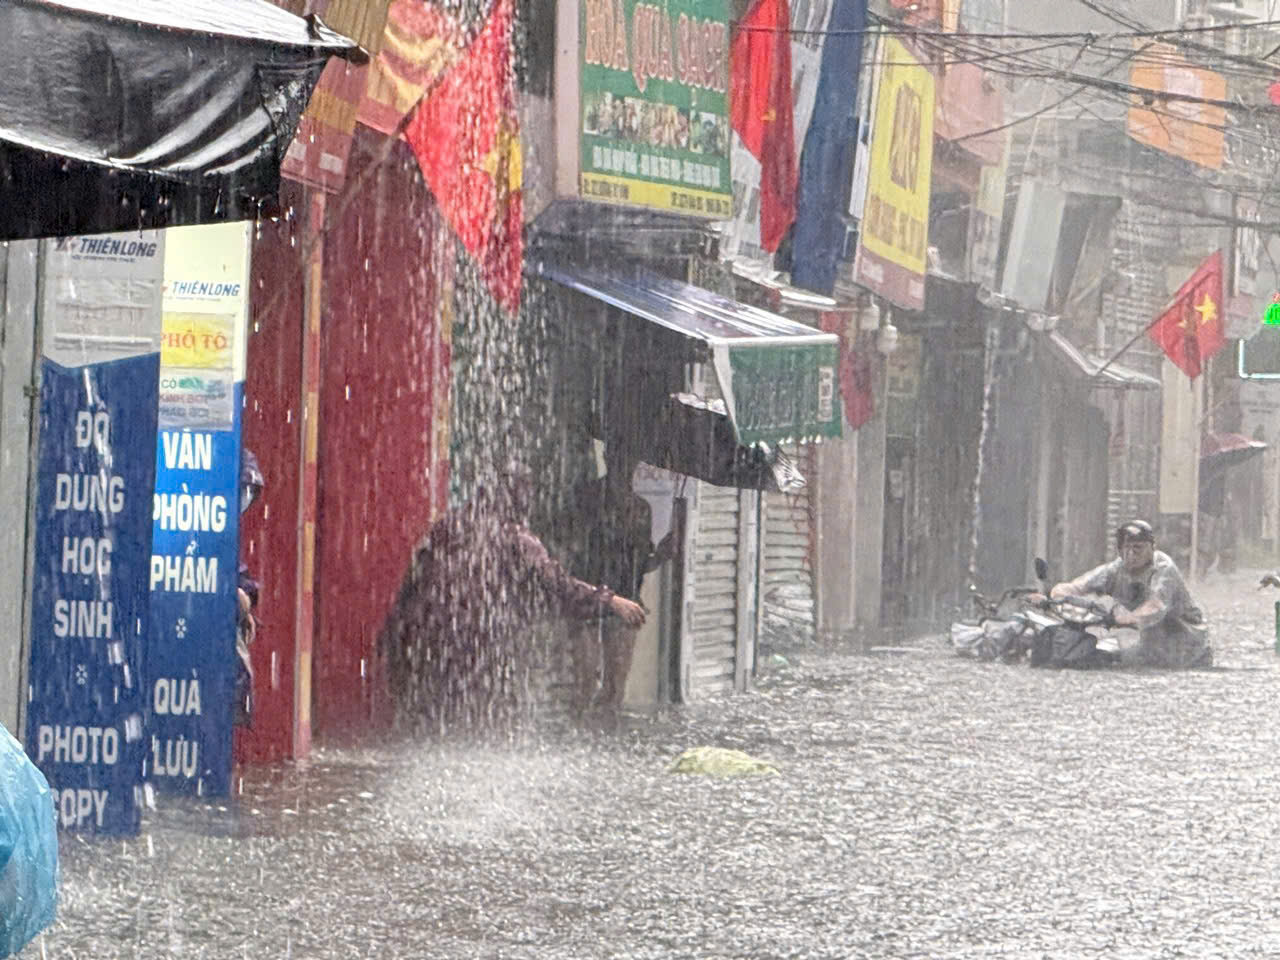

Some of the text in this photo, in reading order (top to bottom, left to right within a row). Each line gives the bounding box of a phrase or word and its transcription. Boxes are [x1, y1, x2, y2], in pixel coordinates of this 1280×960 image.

[62, 535, 113, 586] HỌC
[150, 540, 218, 594] PHẨM
[53, 600, 113, 639] SINH
[154, 667, 202, 716] QUÀ
[38, 724, 119, 765] PHOTO
